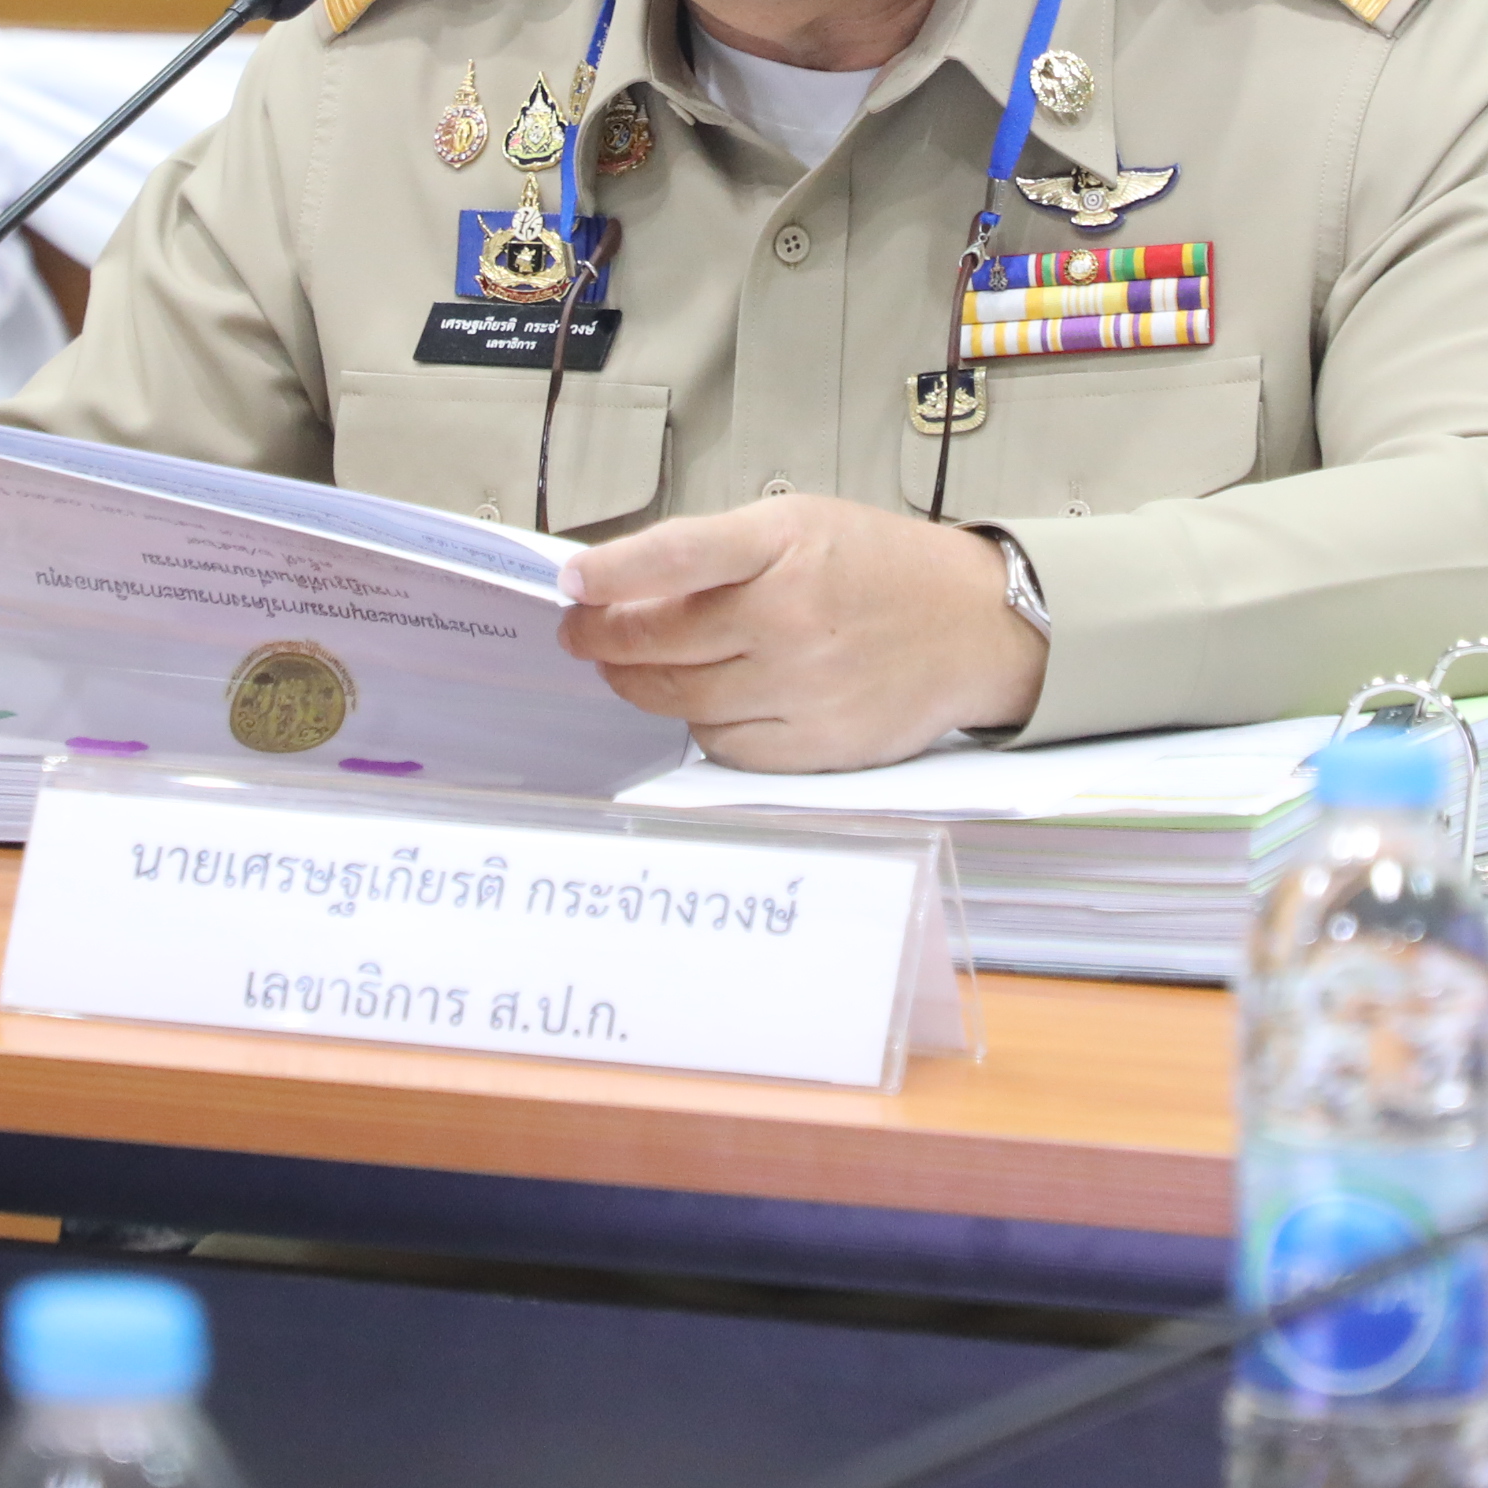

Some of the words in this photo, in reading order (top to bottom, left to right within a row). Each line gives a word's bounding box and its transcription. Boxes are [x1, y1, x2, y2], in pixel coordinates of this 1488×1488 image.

[440, 316, 518, 335] เศรษฐเกียรติ
[523, 318, 599, 336] กระจ่วงษ์
[485, 336, 538, 351] เลขาธิการ
[131, 841, 509, 918] นายเศรษฐเกียรติ
[525, 868, 805, 937] กระจ่างวงษ์
[242, 961, 470, 1027] เลขาธิการ
[488, 984, 630, 1043] ส.ป.ก.
